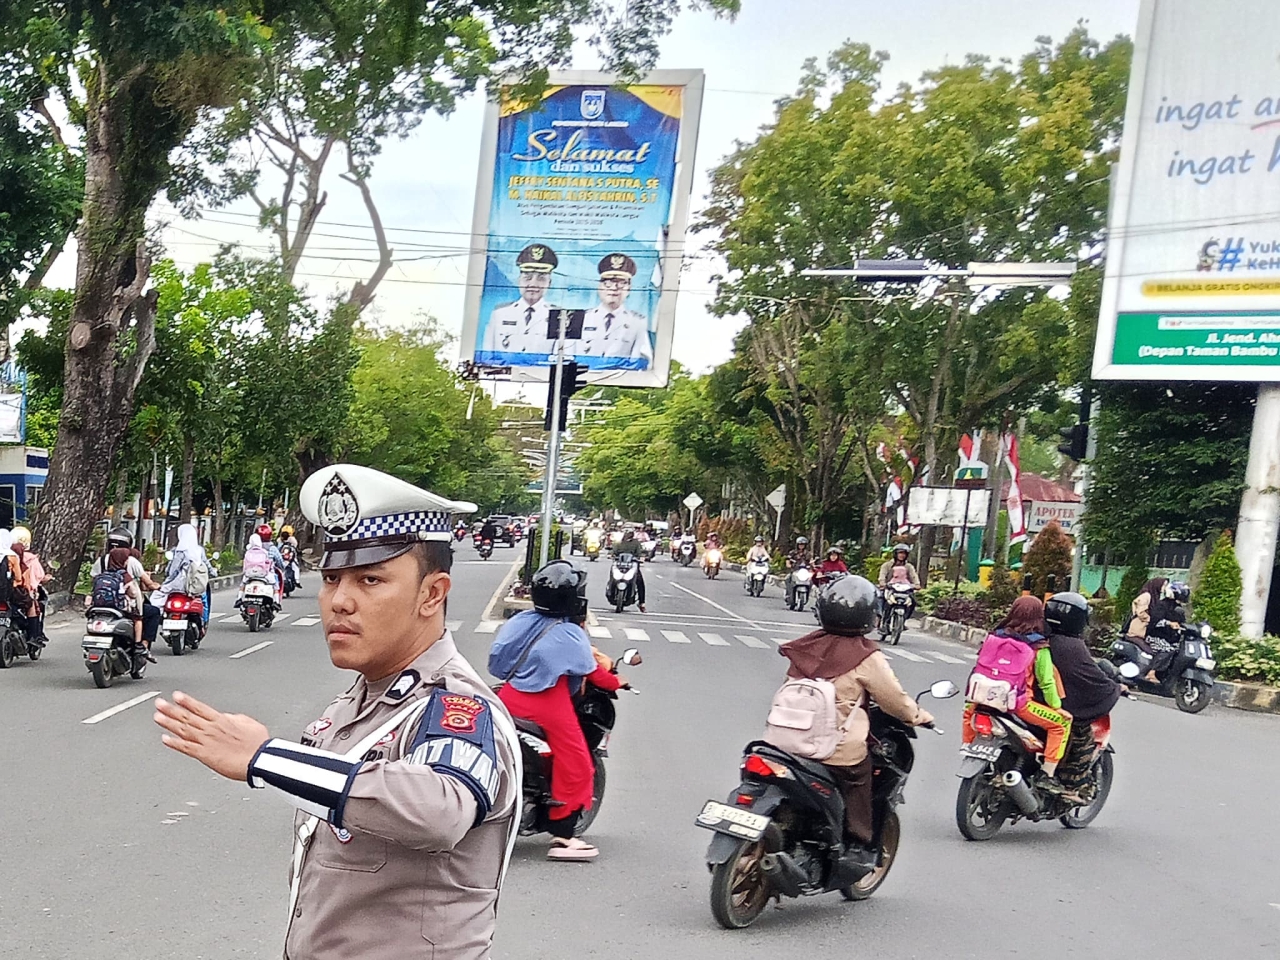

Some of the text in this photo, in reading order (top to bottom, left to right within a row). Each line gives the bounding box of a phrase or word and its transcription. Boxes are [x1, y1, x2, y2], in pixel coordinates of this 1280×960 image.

[1155, 94, 1243, 131] ingat
[513, 129, 651, 164] Selamat
[550, 158, 635, 174] dan sukses
[1167, 148, 1256, 185] ingat
[1157, 283, 1202, 292] BELANJA
[1204, 283, 1241, 292] GRATIS
[1138, 345, 1184, 359] (Depan
[1185, 346, 1229, 356] Taman
[1034, 506, 1076, 519] APOTEK
